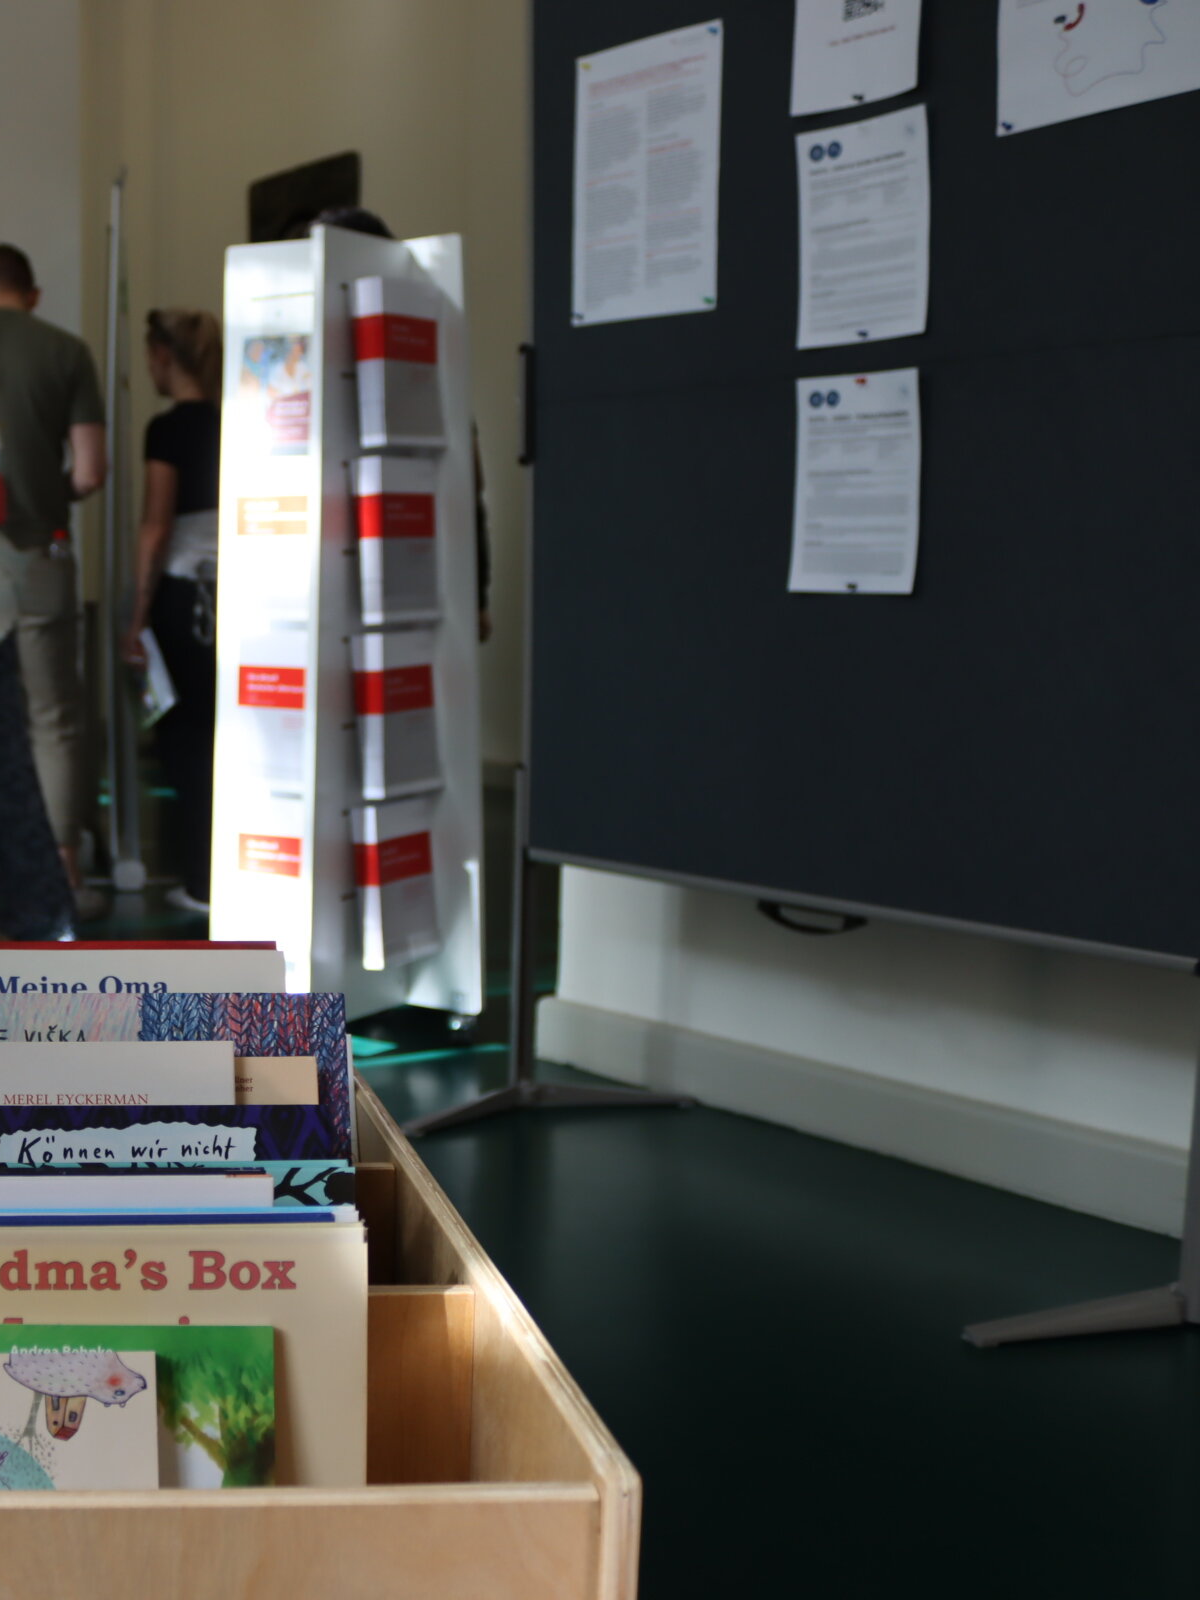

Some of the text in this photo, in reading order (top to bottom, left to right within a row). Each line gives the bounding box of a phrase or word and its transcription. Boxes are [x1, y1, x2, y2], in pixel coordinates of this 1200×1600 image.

[99, 976, 167, 993] Oma
[4, 1094, 52, 1105] MEREL
[56, 1094, 148, 1105] EYCKERMAN
[18, 1135, 236, 1164] Können wir nicht
[187, 1250, 297, 1292] Box
